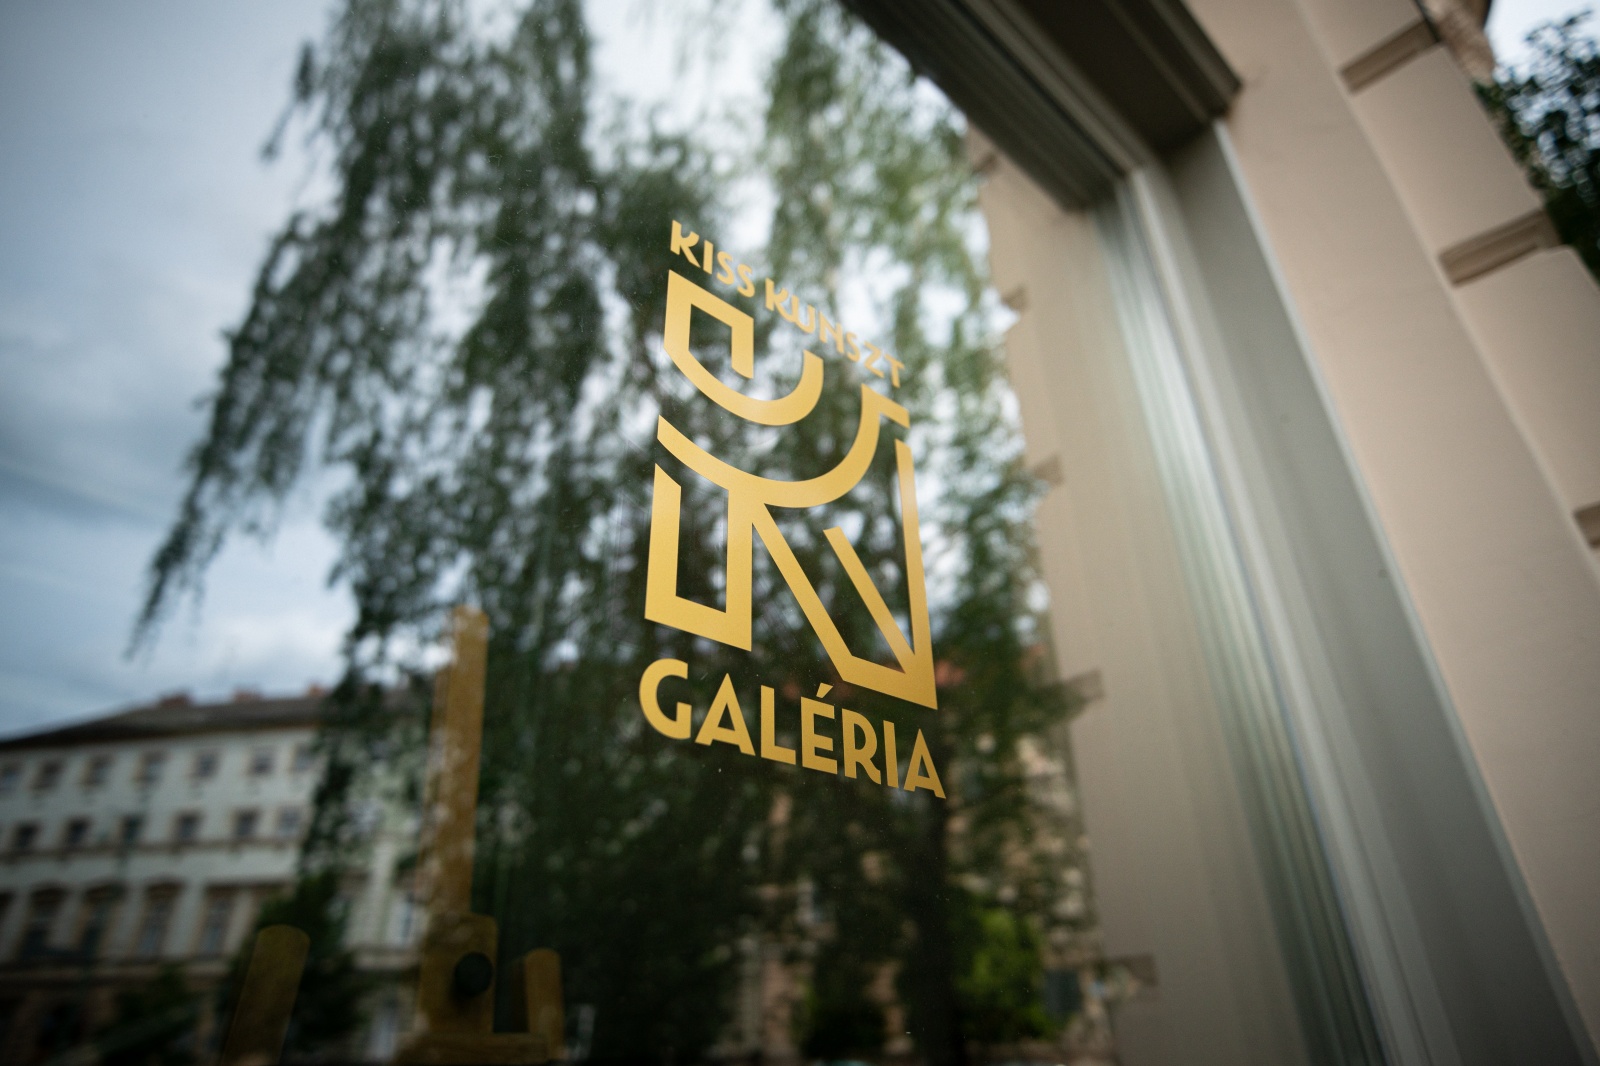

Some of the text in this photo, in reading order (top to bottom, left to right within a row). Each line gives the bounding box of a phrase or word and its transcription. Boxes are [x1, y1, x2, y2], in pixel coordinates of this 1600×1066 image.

[670, 219, 905, 389] KISS KUNSZT
[639, 658, 947, 799] GALÉRIA
